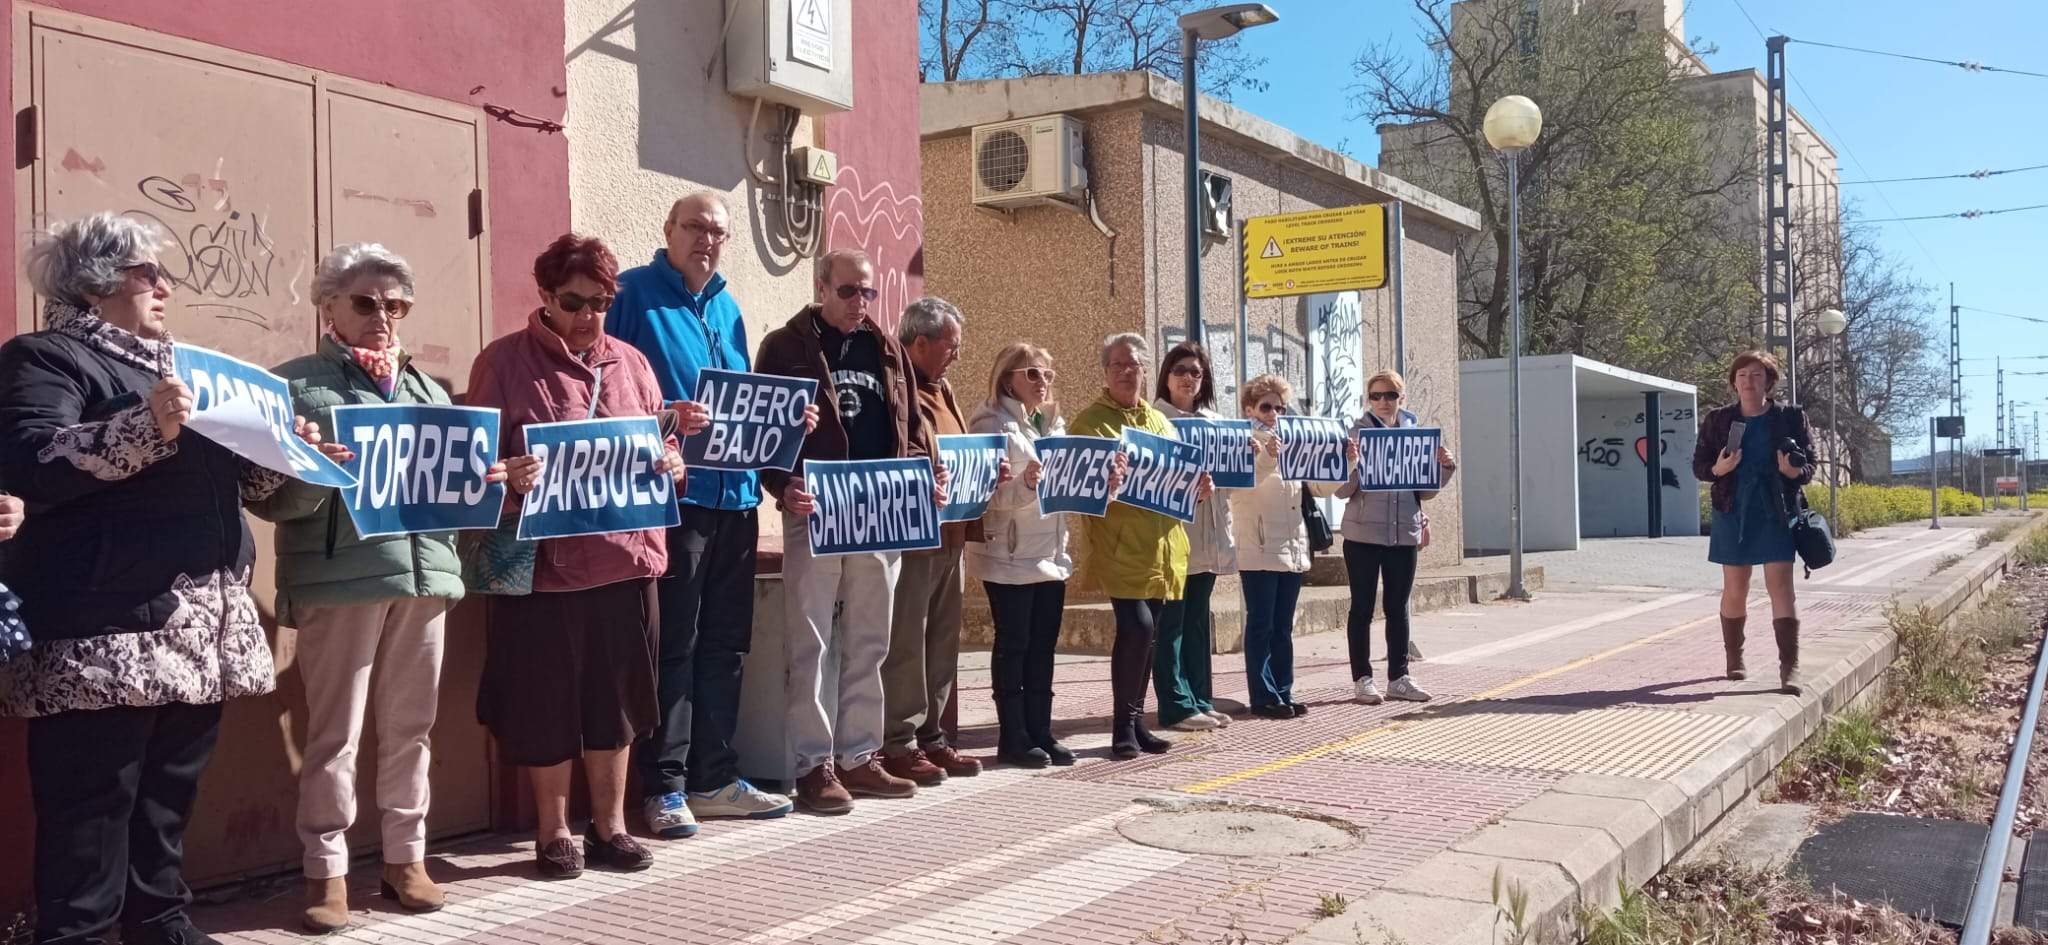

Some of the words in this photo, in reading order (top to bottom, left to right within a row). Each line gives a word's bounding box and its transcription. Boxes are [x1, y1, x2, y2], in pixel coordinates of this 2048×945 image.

[1283, 236, 1316, 245] ¡EXTREME
[1328, 230, 1367, 240] ATENCIÓN!
[1290, 244, 1318, 253] BEWARE
[1331, 240, 1360, 249] TRAINS!
[700, 379, 810, 428] ALBERO
[352, 423, 489, 511] TORRES
[703, 422, 783, 464] BAJO
[1278, 417, 1347, 481] ROBRES
[1359, 435, 1440, 486] SANGARREN
[524, 432, 670, 517] BARBUES
[1040, 447, 1118, 500] PIRACES
[1117, 442, 1203, 516] GRAÑÉN
[808, 468, 934, 548] SANGARREN
